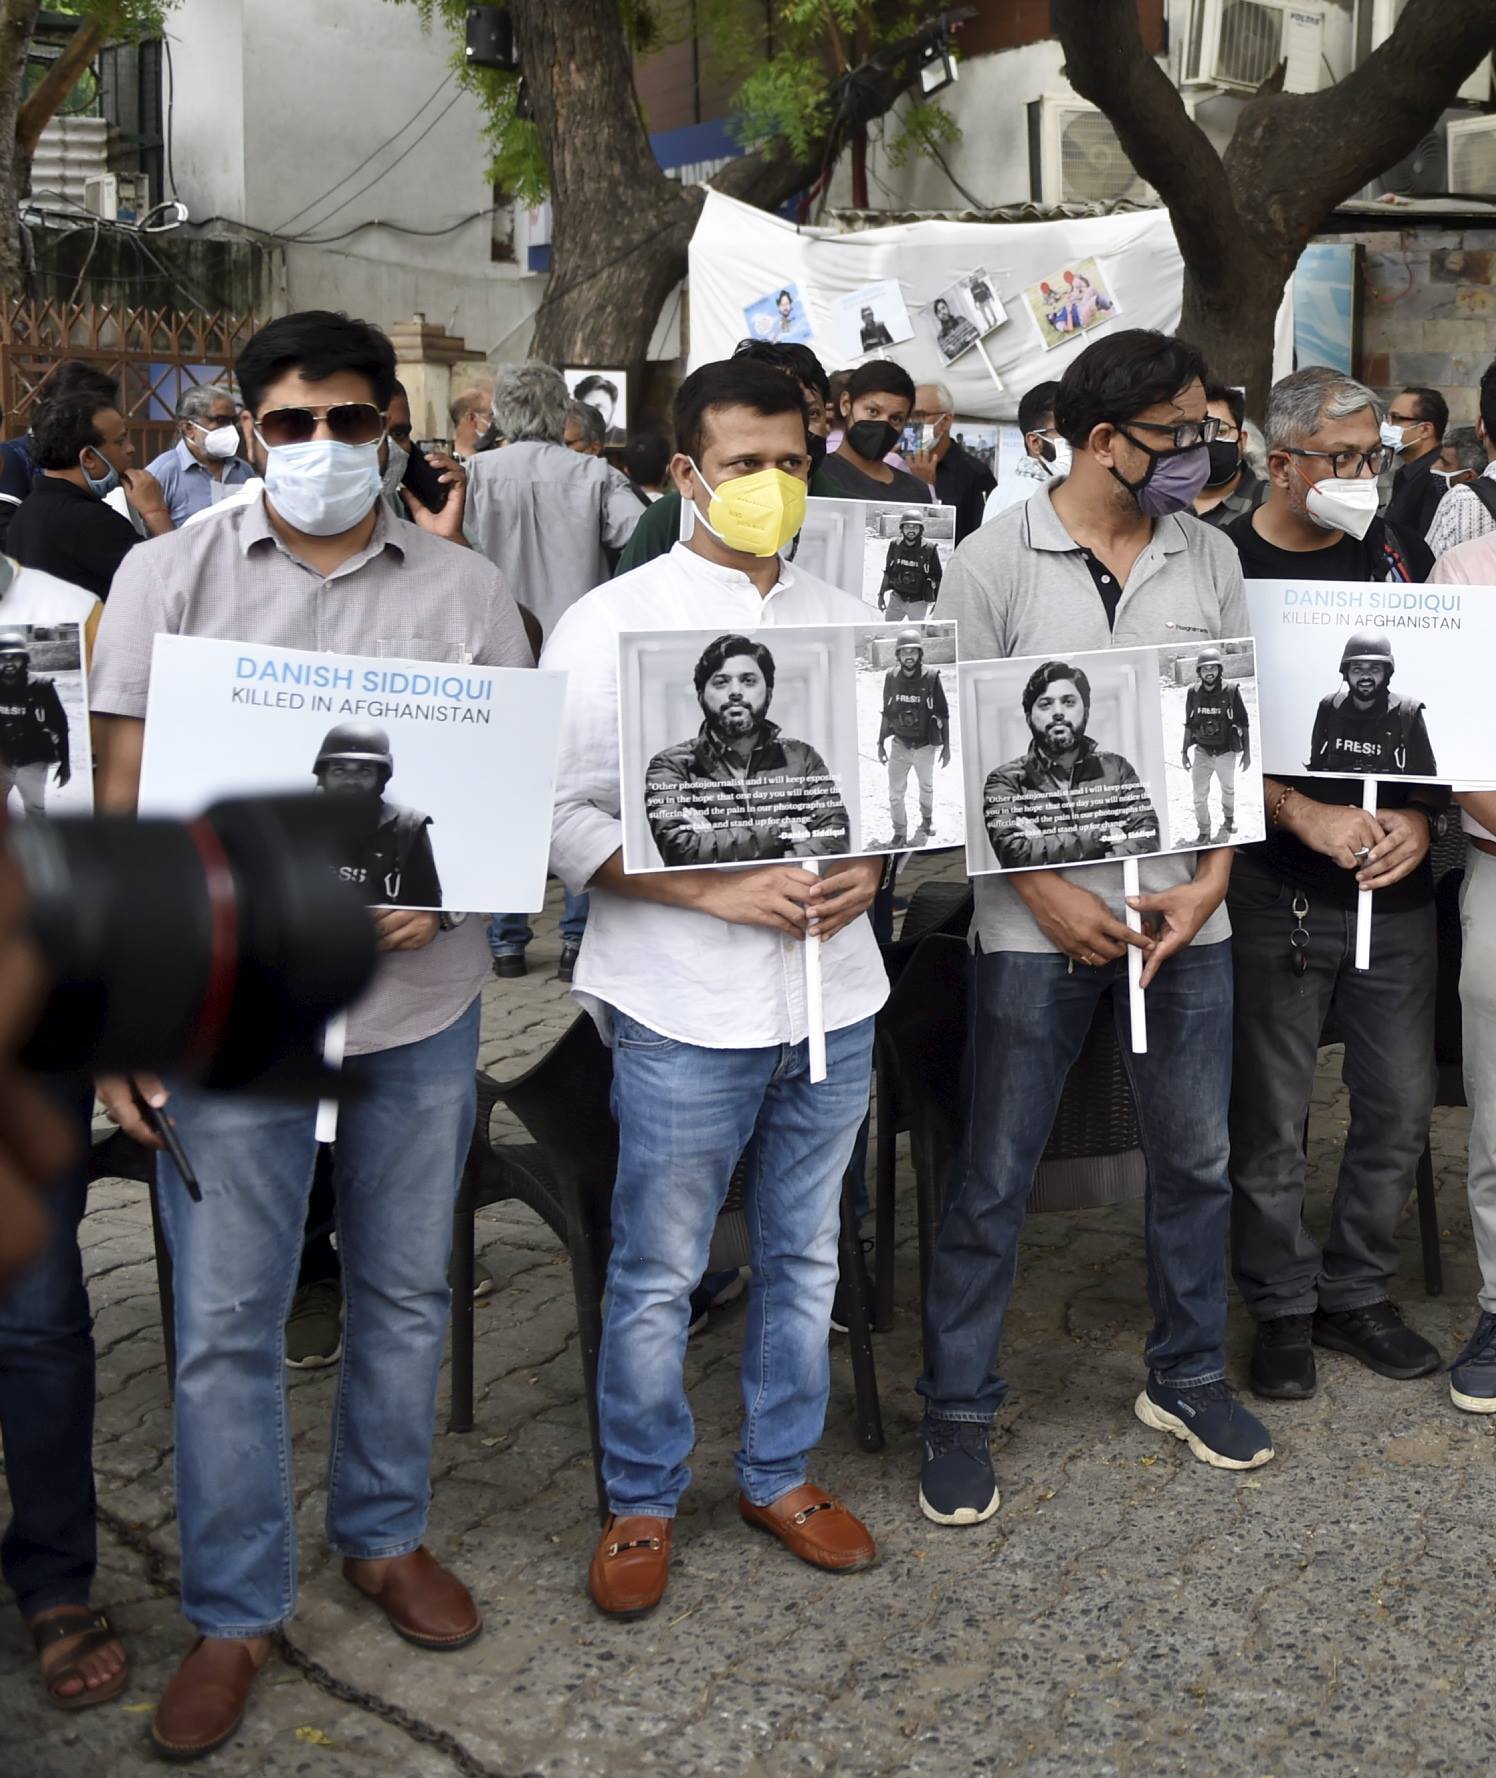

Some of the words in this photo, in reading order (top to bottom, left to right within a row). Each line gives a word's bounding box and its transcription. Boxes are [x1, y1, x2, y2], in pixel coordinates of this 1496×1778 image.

[1284, 589, 1363, 608] DANISH
[1369, 592, 1461, 613] SIDDIQUI
[1282, 611, 1331, 625] KILLED
[1336, 613, 1350, 626] IN
[1354, 614, 1462, 630] AFGHANISTAN
[235, 657, 353, 690] DANISH
[362, 670, 493, 702] SIDDIQUI
[231, 686, 305, 711] KILLED
[311, 696, 332, 713] IN
[338, 699, 491, 724] AFGHANISTAN
[746, 778, 761, 786] and
[768, 776, 784, 784] will
[786, 776, 805, 784] keep
[648, 798, 664, 806] you
[692, 795, 714, 803] hope
[753, 791, 768, 799] day
[769, 791, 785, 799] you
[787, 788, 802, 796] will
[711, 807, 725, 815] the
[727, 806, 745, 816] pain
[773, 801, 825, 812] photographs
[712, 820, 729, 828] and
[730, 818, 753, 827] stand
[755, 819, 766, 827] up
[768, 817, 780, 825] for
